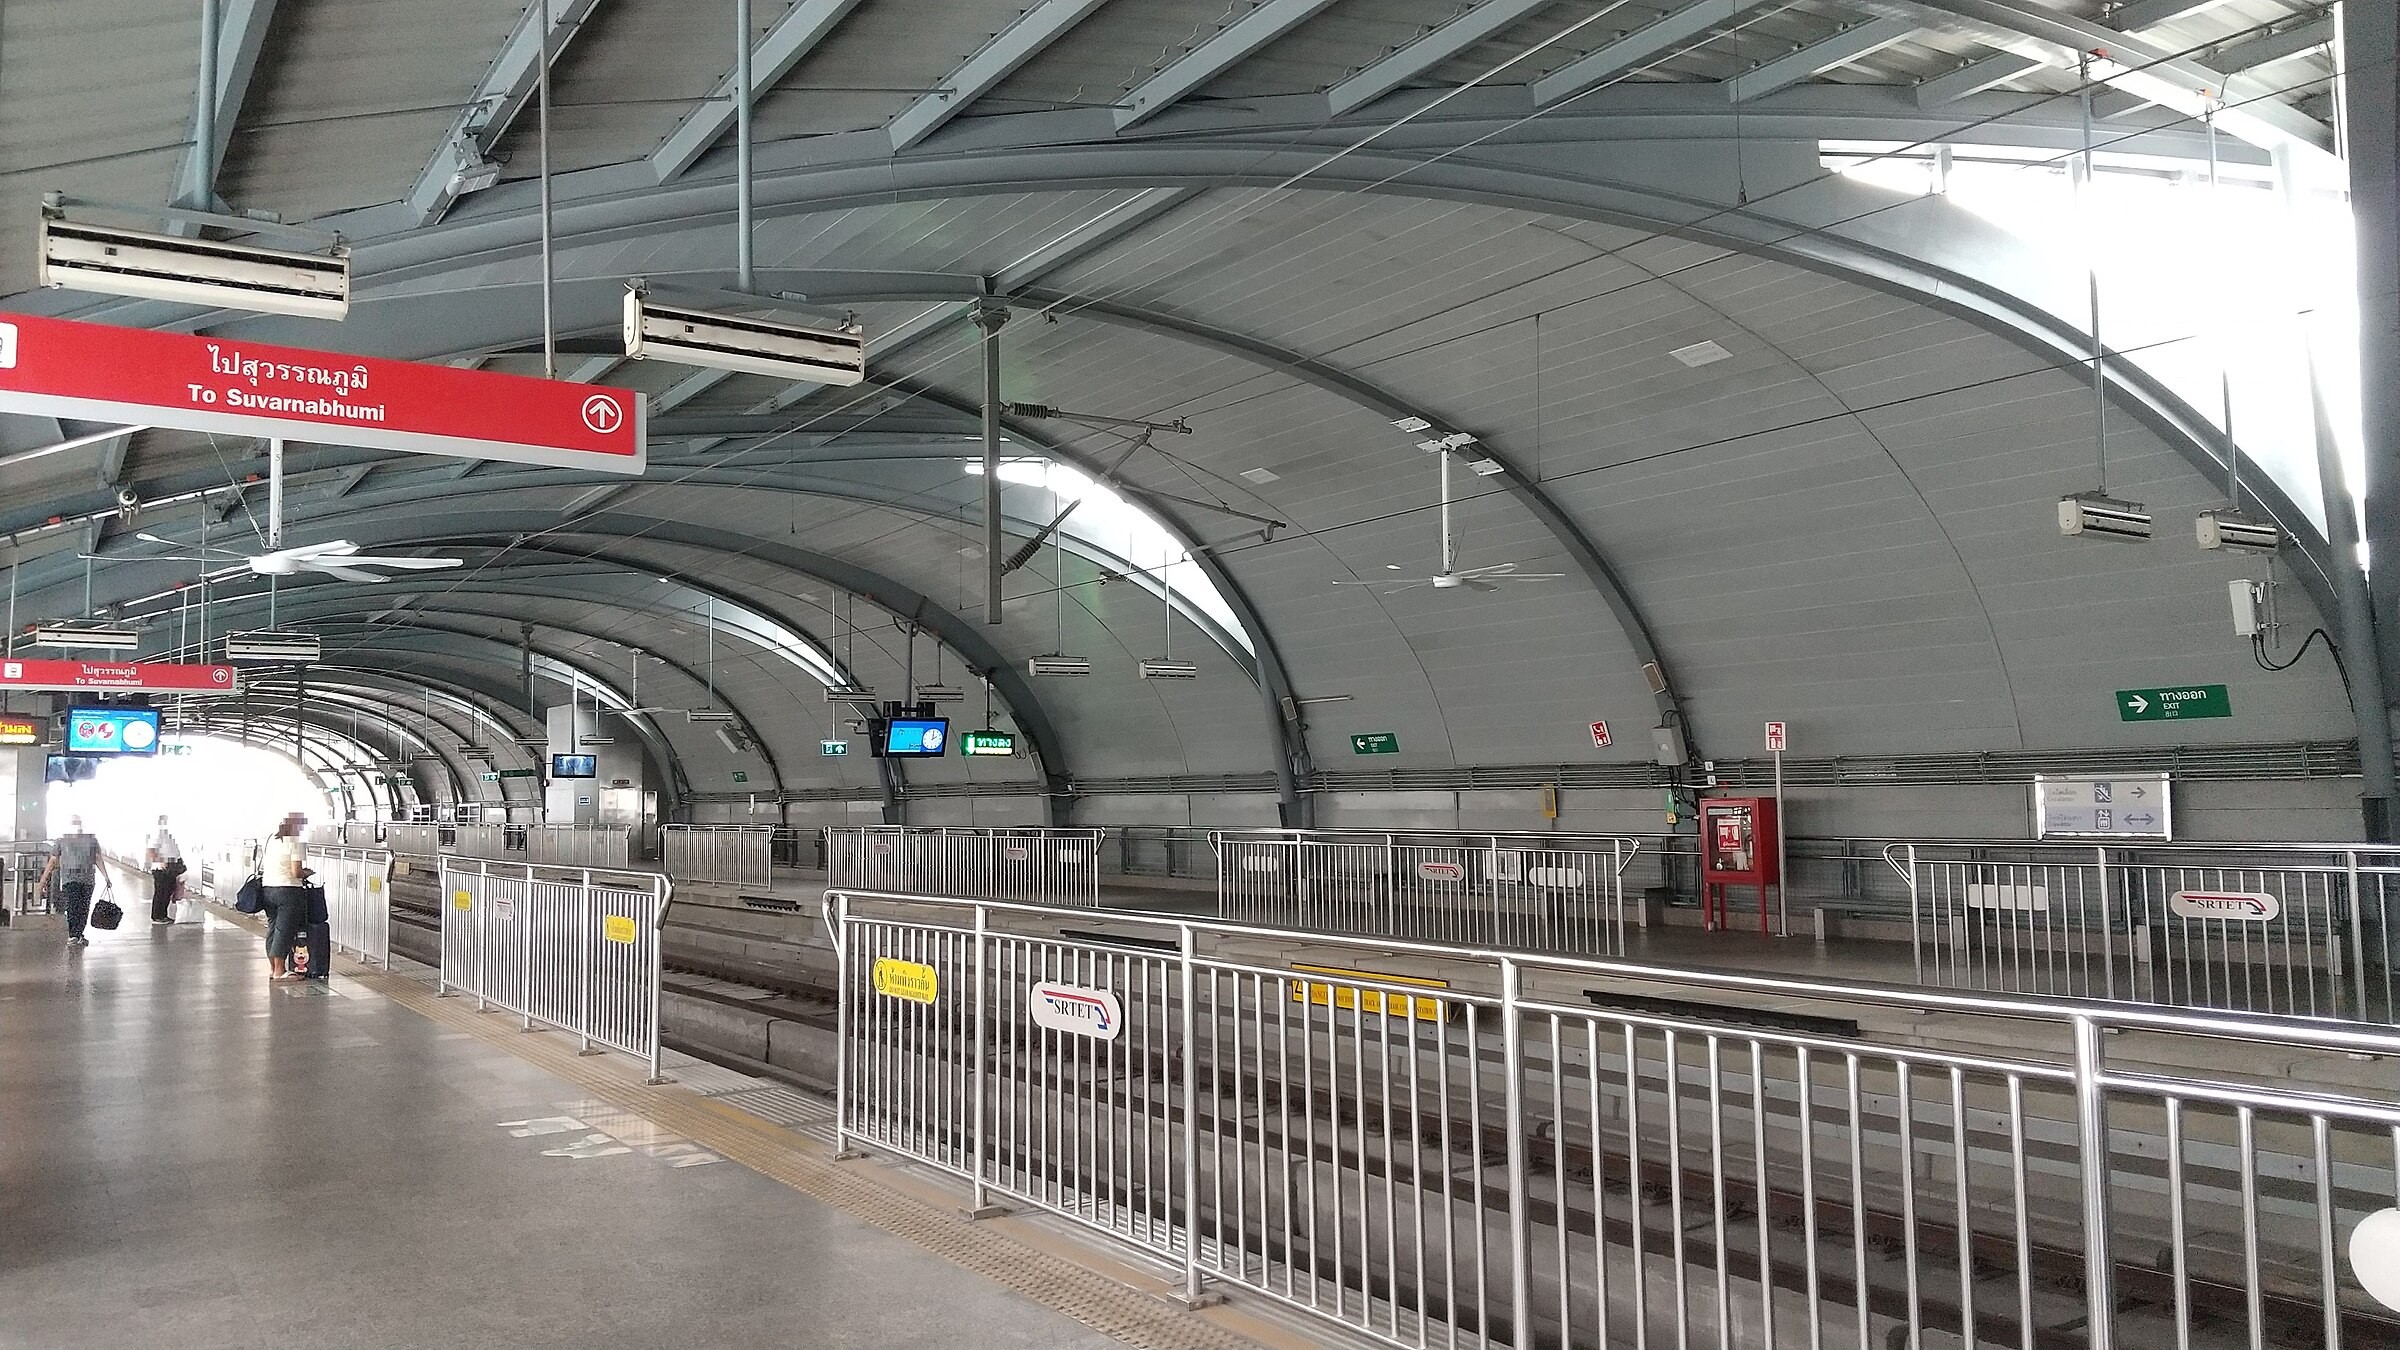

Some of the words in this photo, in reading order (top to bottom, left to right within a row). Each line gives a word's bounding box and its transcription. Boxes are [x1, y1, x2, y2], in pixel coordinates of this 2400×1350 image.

[207, 343, 368, 396] ไปสุวรรณภูมิ
[187, 384, 217, 403] To
[227, 388, 385, 421] Suvarnabhumi
[2159, 690, 2207, 701] ทางออก
[2163, 702, 2180, 710] EXIT
[976, 737, 1011, 747] ทางลง
[2197, 900, 2245, 910] SRTET
[1054, 999, 1093, 1019] SRTET
